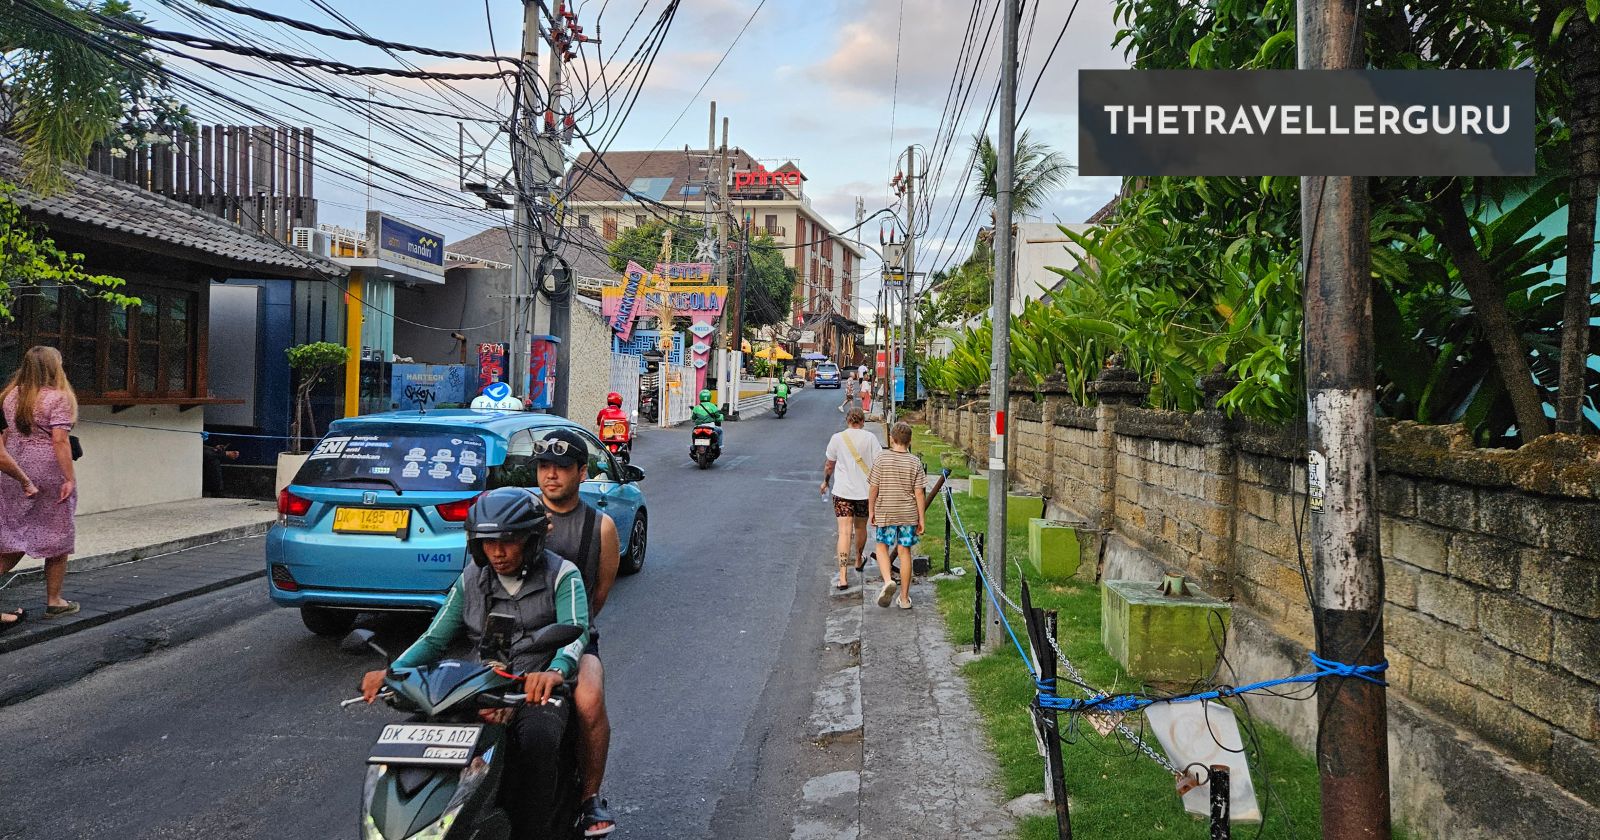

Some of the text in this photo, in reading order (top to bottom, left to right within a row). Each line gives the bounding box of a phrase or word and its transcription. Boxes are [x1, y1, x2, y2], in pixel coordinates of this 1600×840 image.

[735, 165, 800, 191] prima
[408, 242, 431, 258] mandiri
[614, 271, 642, 332] PARKING
[314, 440, 347, 454] SNI
[336, 509, 350, 523] DK
[360, 510, 386, 524] 1485
[417, 553, 452, 563] IV 401
[382, 727, 403, 741] DK
[407, 728, 445, 742] 4365
